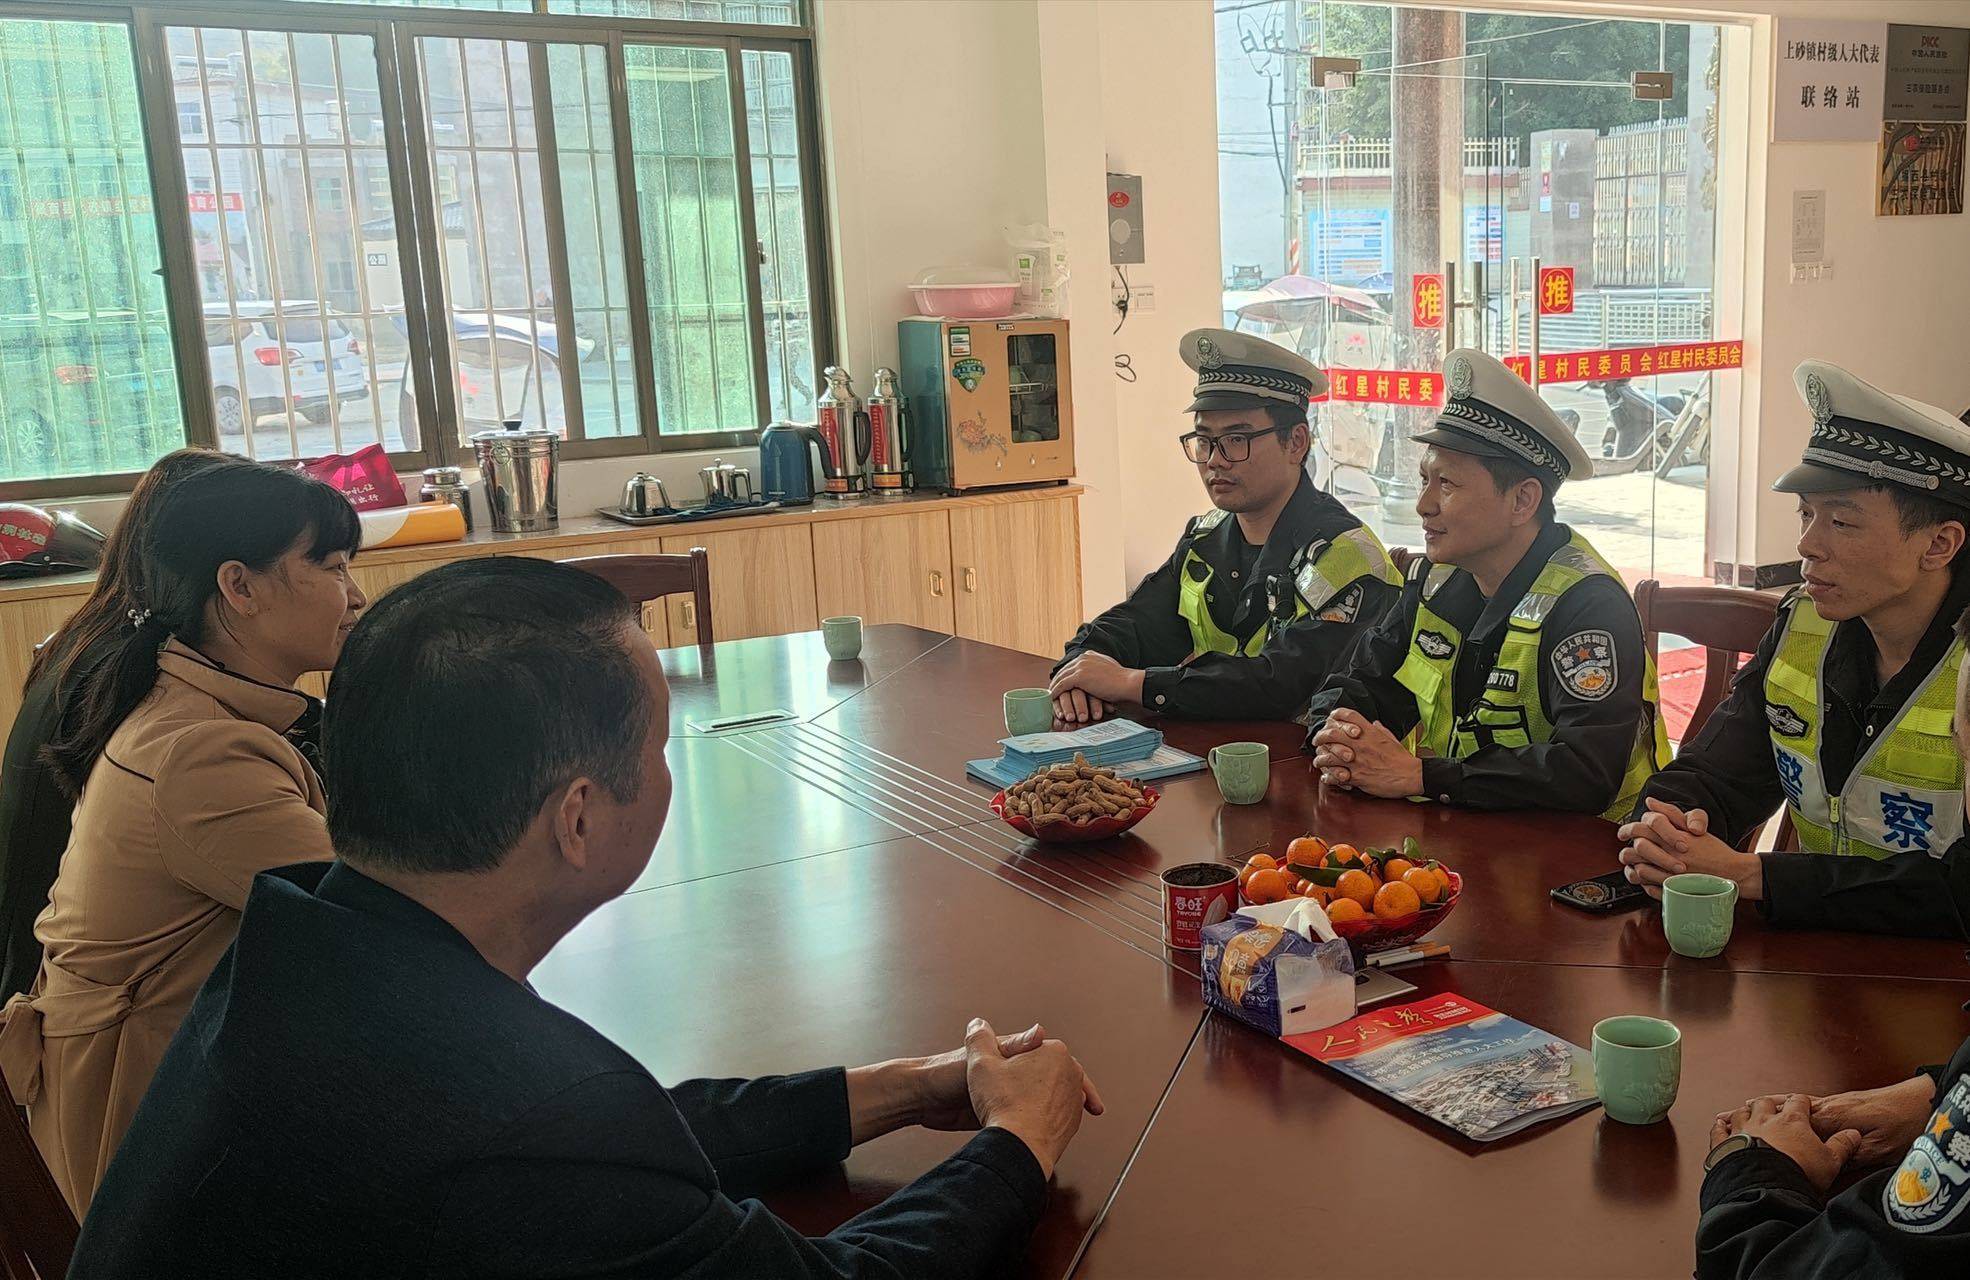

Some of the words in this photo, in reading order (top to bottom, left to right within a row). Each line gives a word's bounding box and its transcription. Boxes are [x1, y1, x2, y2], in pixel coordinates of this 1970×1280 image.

[1784, 40, 1880, 63] 上砂镇村级人大代表
[1801, 85, 1860, 108] 联络站
[1418, 283, 1442, 320] 推
[1546, 275, 1569, 308] 推
[1657, 345, 1742, 370] 红星村民委员会
[1335, 374, 1433, 402] 红星村民委
[1554, 634, 1609, 661] 中华人民共和国
[1776, 747, 1803, 812] 警
[1880, 791, 1933, 850] 察
